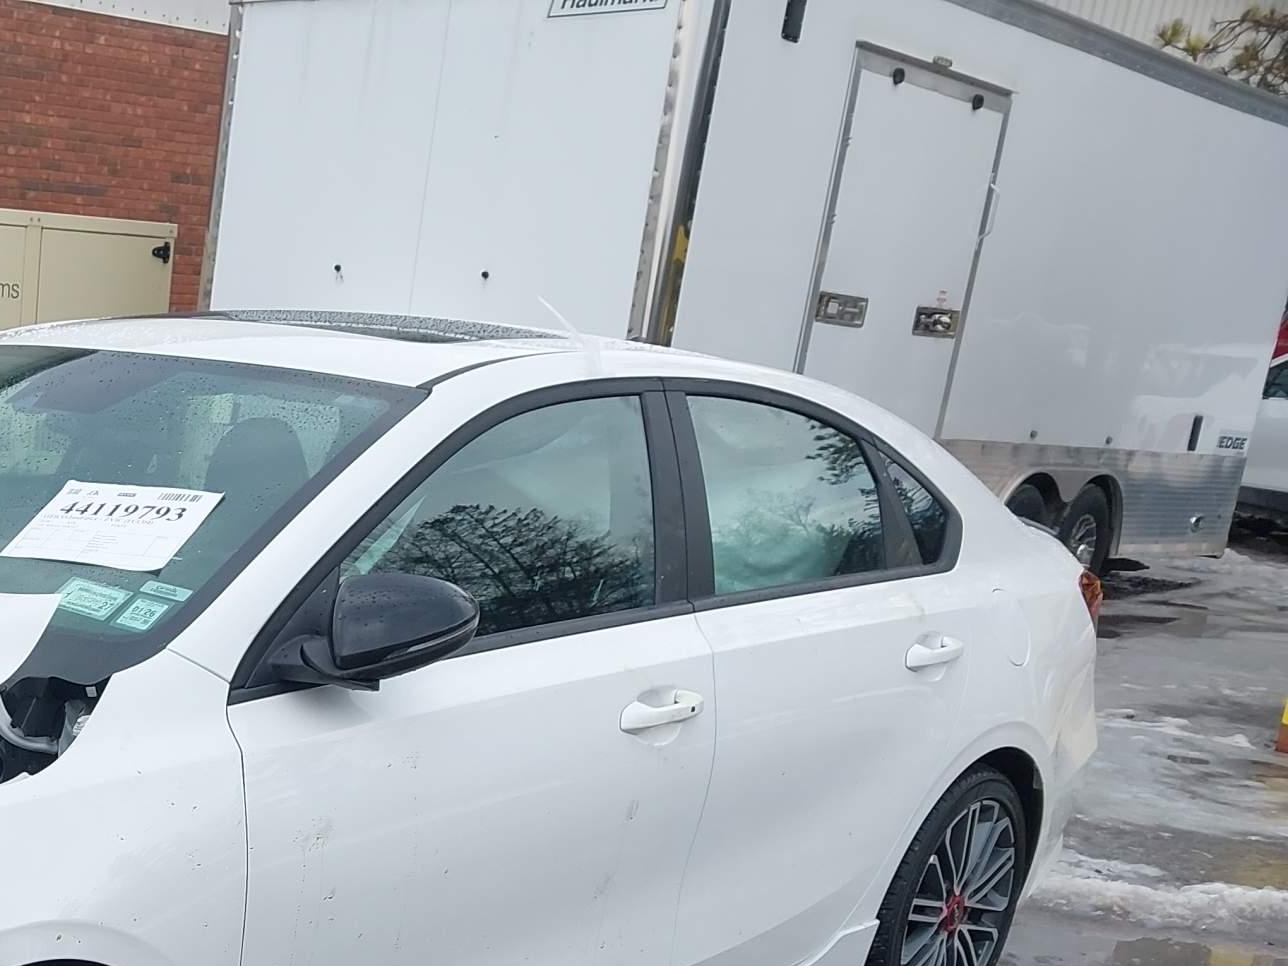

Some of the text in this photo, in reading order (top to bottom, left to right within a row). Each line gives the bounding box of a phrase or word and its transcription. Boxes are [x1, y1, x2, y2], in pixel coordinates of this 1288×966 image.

[560, 0, 659, 9] Haulm
[1218, 435, 1248, 450] EDGE
[60, 500, 188, 522] 44119793
